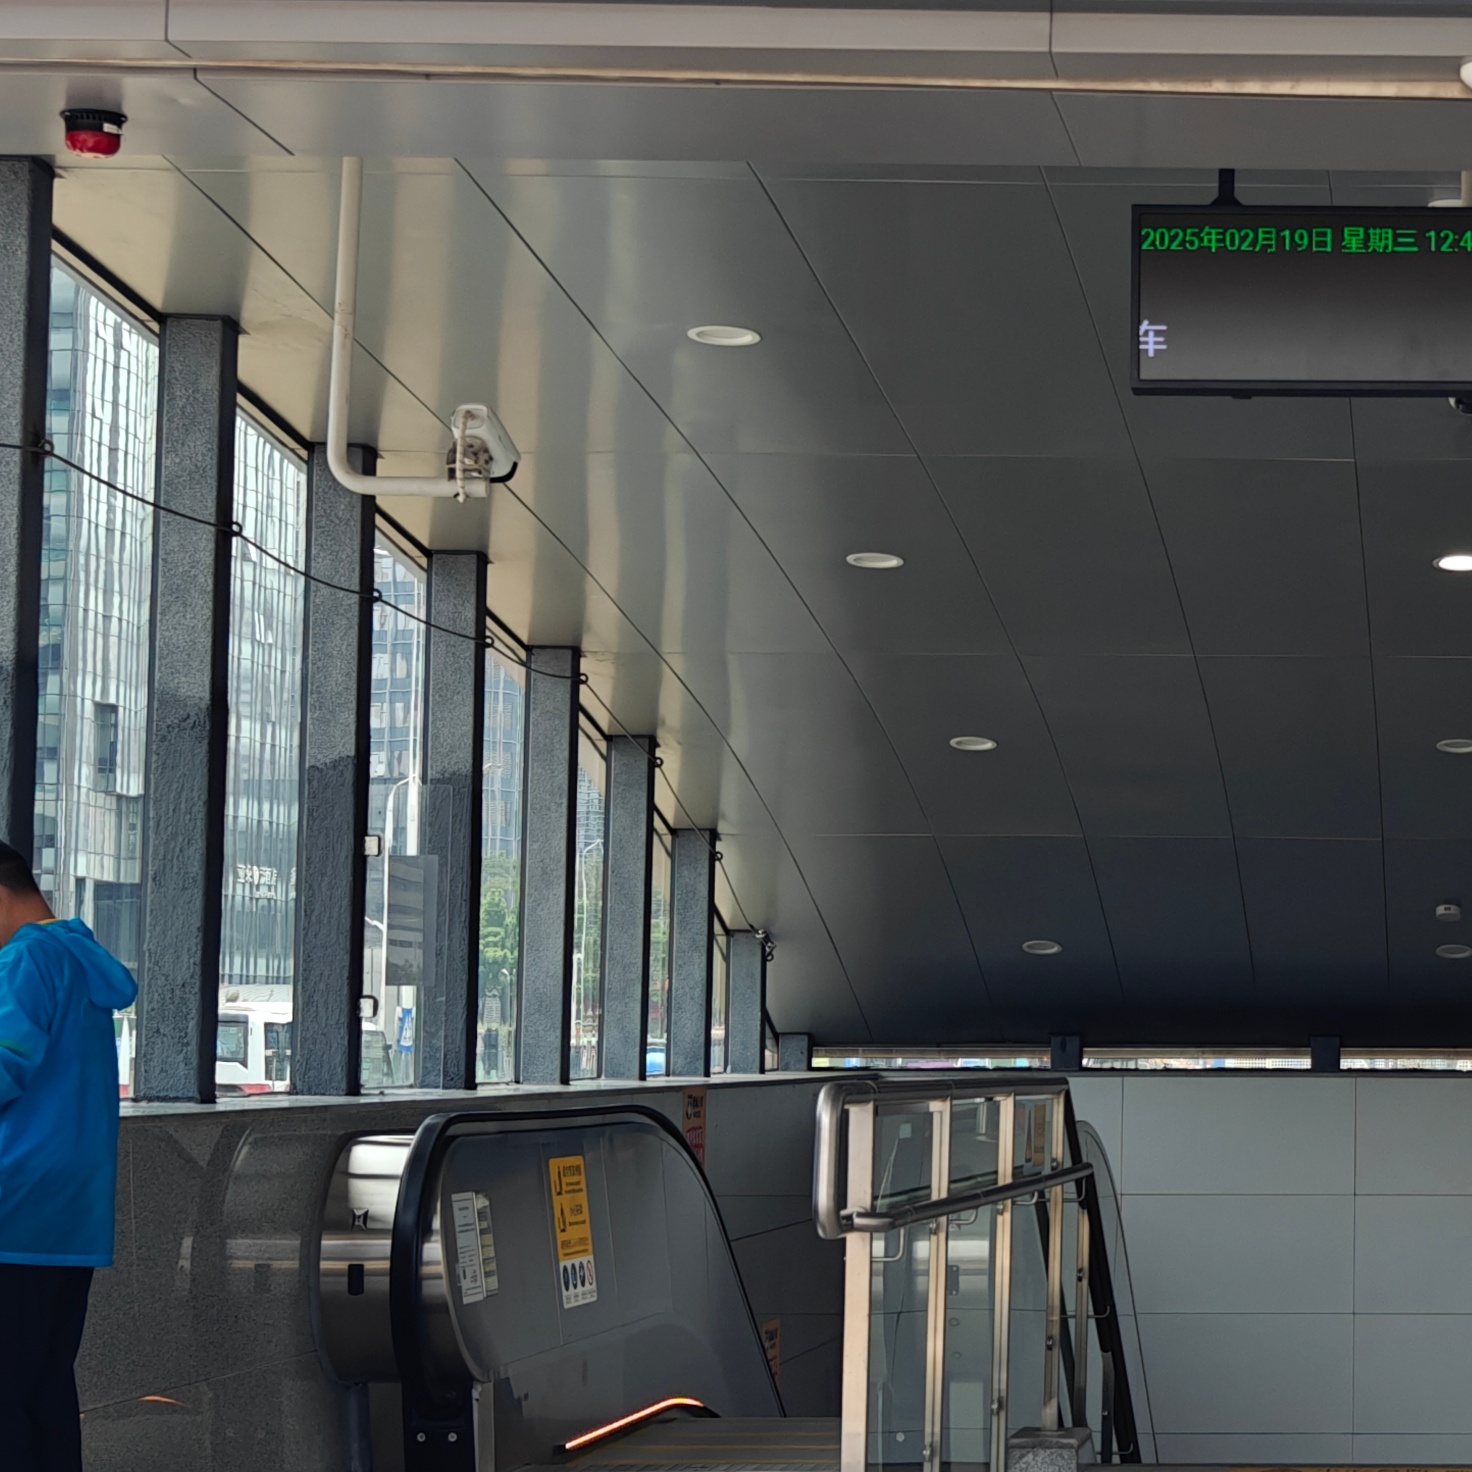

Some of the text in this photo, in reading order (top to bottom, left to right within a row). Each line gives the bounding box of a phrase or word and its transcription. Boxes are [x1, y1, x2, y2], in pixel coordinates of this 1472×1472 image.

[1140, 227, 1334, 254] 2025年02月19日
[1340, 227, 1420, 254] 星期三
